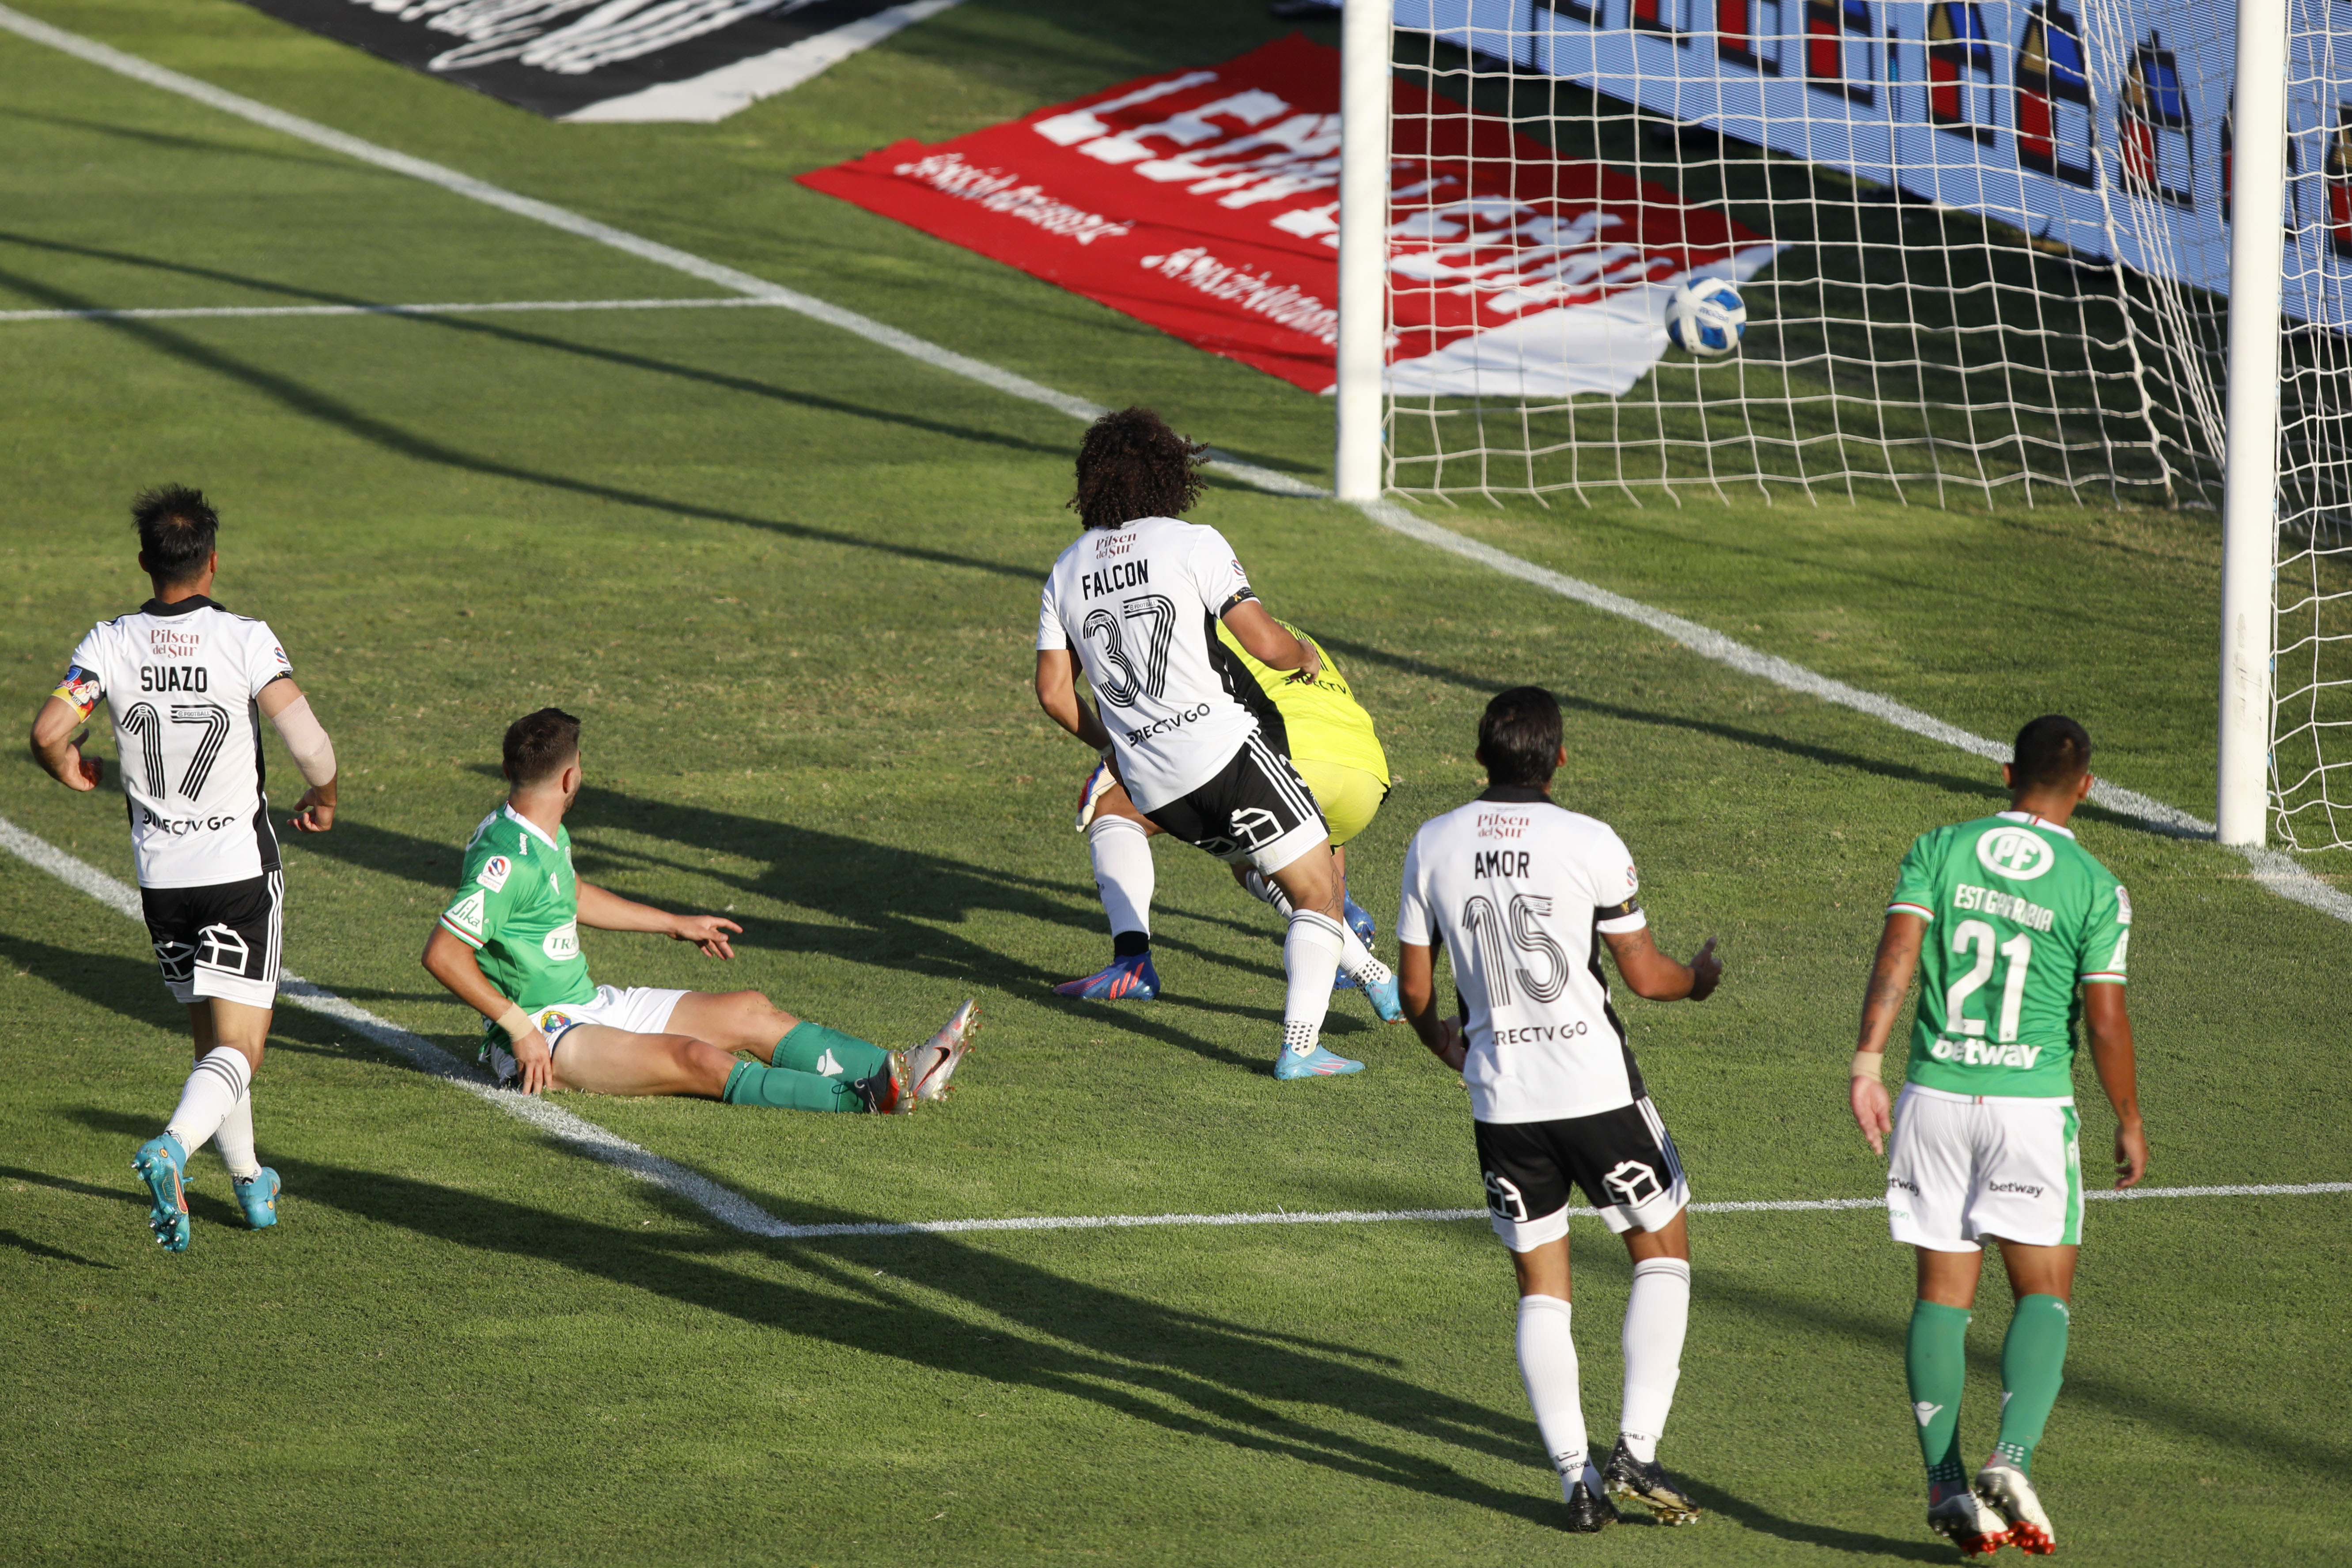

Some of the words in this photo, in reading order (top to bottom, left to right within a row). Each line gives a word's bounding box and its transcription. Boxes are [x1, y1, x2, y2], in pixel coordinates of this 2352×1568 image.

[1096, 534, 1136, 551] Pilsen
[1096, 548, 1108, 559] del
[1108, 543, 1133, 558] Sur
[1082, 559, 1148, 600] FALCON
[151, 629, 199, 644] Pilsen
[153, 644, 166, 655] del
[168, 644, 197, 659] Sur
[1083, 594, 1176, 708] 37
[140, 666, 207, 692] SUAZO
[1184, 703, 1210, 722] GO
[121, 701, 230, 802] 17
[1477, 814, 1530, 827] Pilsen
[1478, 827, 1493, 837] del
[1494, 824, 1526, 840] Sur
[519, 832, 529, 856] betway
[1993, 834, 2038, 870] PF
[1474, 850, 1530, 879] AMOR
[451, 898, 480, 928] Sika
[1462, 894, 1568, 1008] 15
[1946, 919, 2032, 1042] 21
[1560, 1021, 1587, 1039] GO
[1931, 1034, 2043, 1069] betway
[1989, 1180, 2045, 1198] betway
